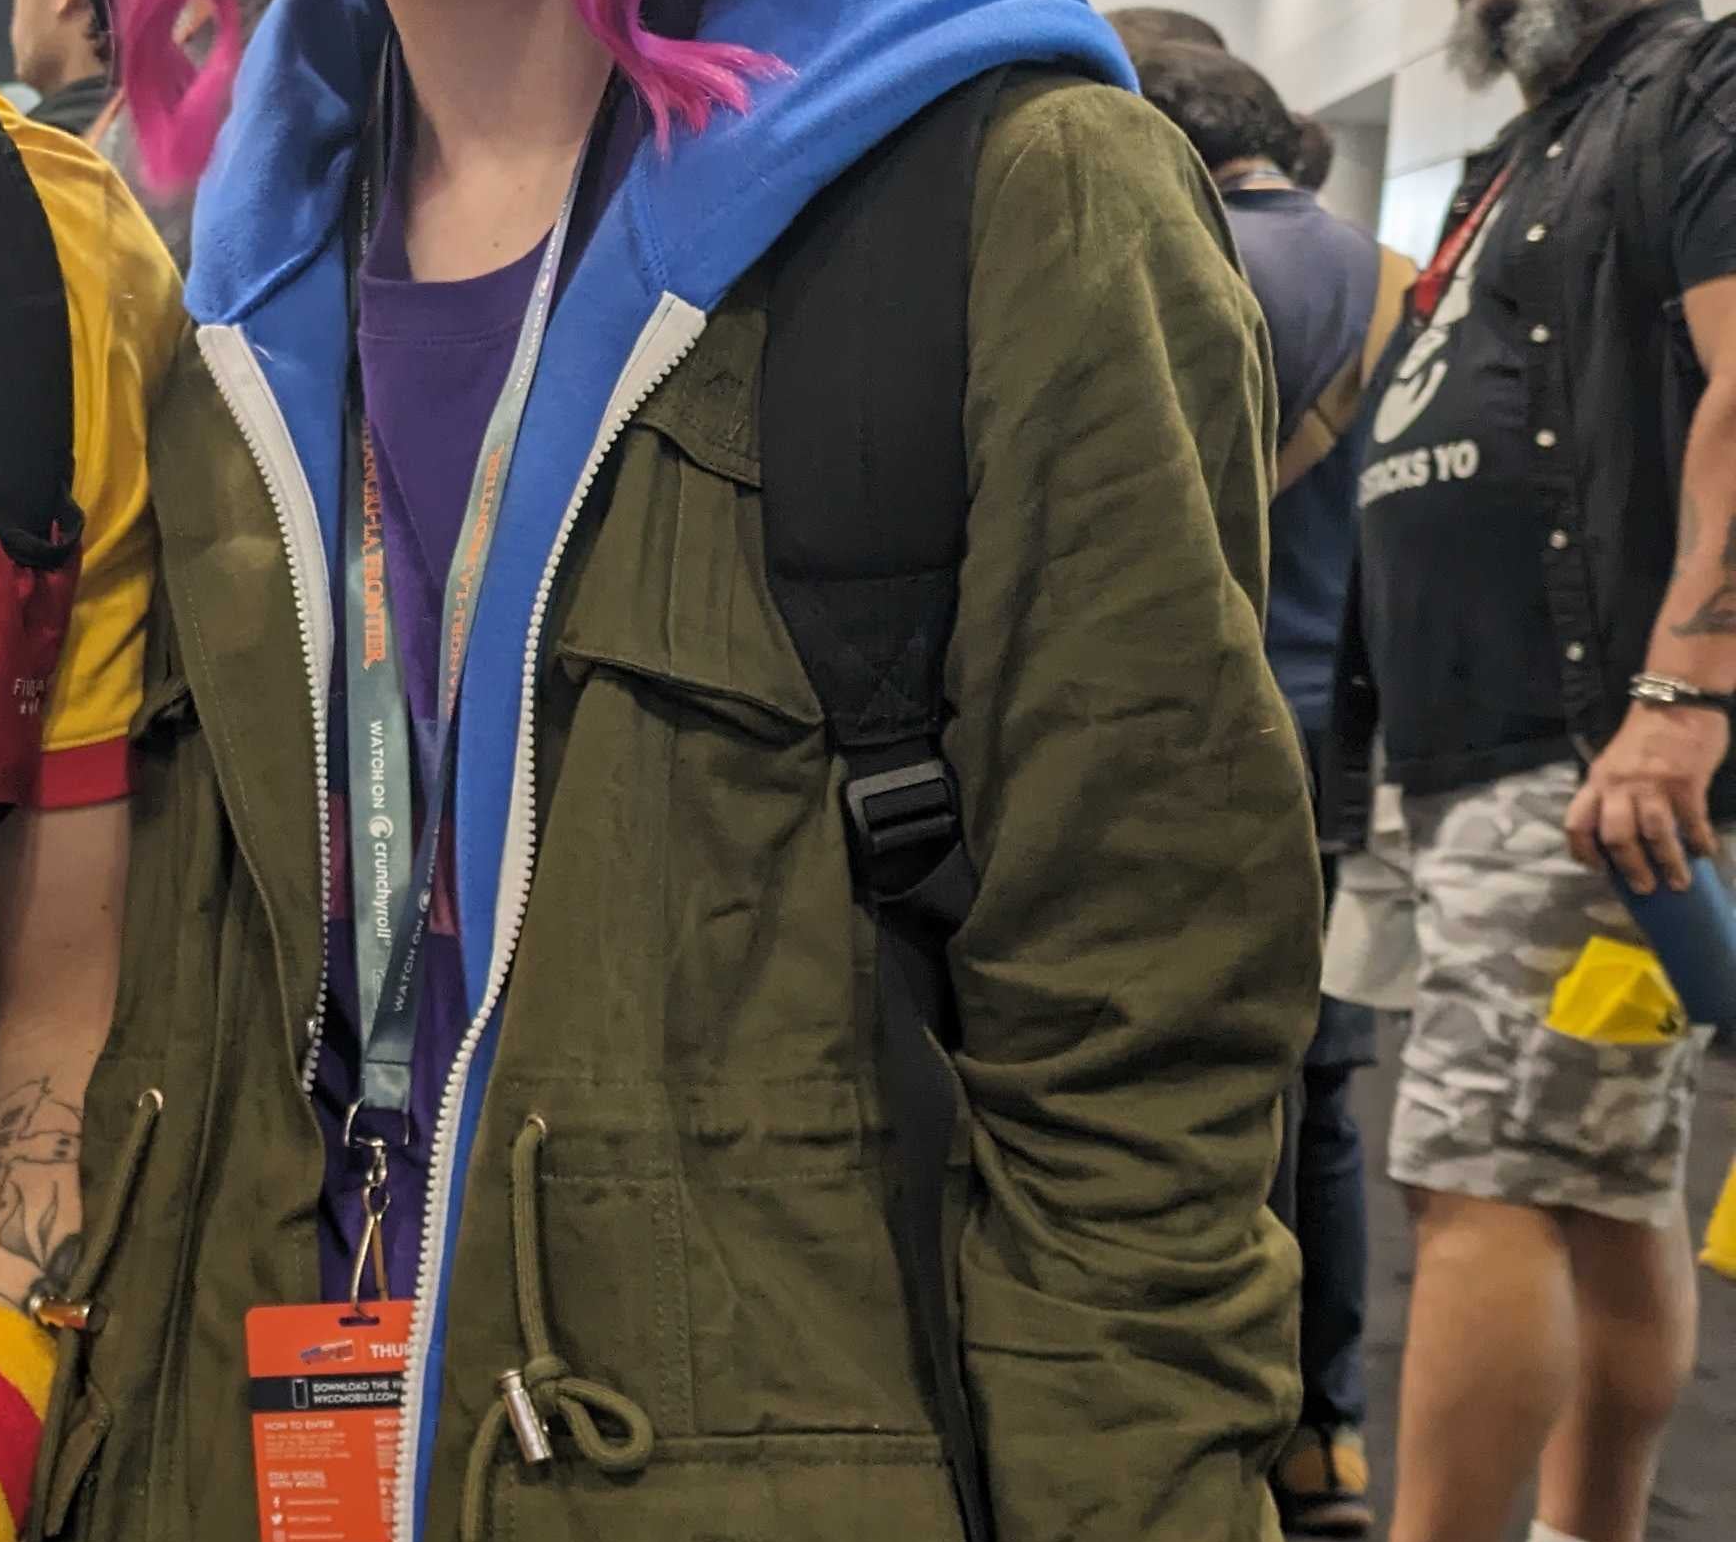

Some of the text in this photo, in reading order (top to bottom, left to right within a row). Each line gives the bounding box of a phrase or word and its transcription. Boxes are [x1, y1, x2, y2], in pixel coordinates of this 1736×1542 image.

[1432, 439, 1480, 481] YO
[369, 720, 385, 809] WATCH ON
[372, 841, 392, 939] crunchyroll
[393, 950, 416, 1012] WATCH
[313, 1381, 370, 1393] DOWNLOAD
